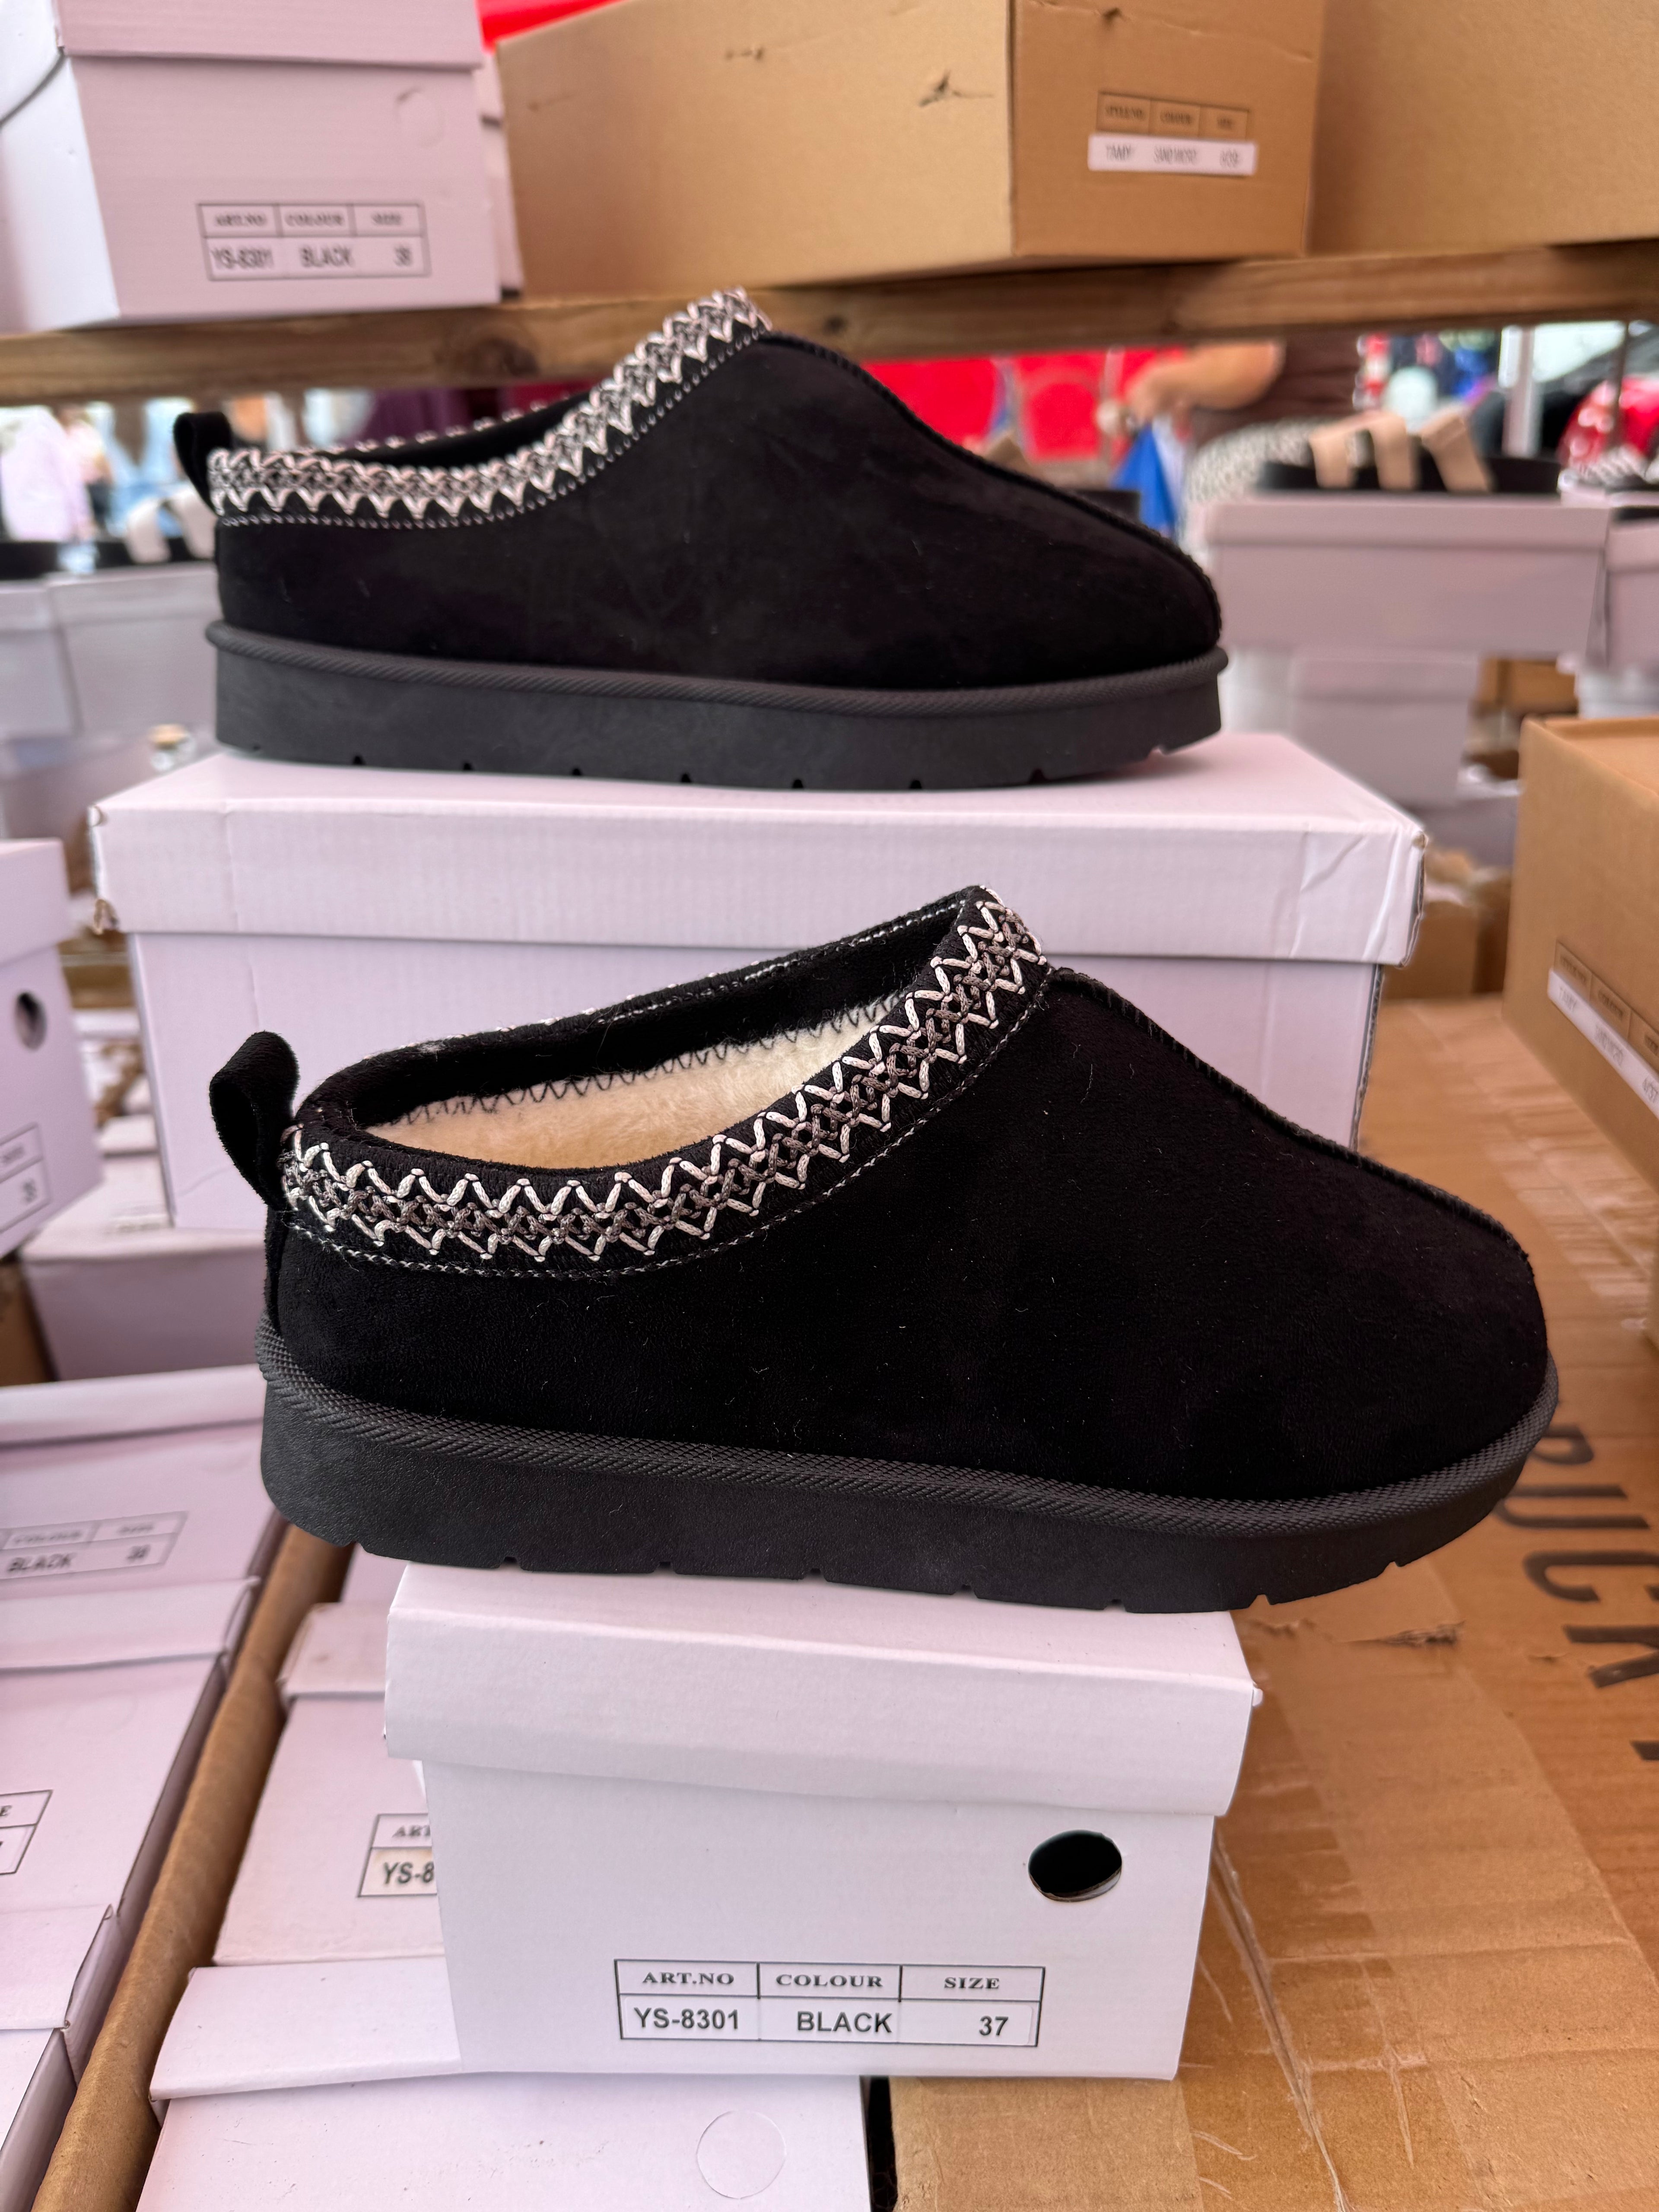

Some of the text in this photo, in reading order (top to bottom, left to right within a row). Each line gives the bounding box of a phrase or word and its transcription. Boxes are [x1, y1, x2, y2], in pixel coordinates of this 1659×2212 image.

[299, 244, 354, 268] BLACK
[642, 1972, 1000, 1989] ART.NO COLOUR SIZE
[634, 2007, 1009, 2036] YS-8301 BLACK 37
